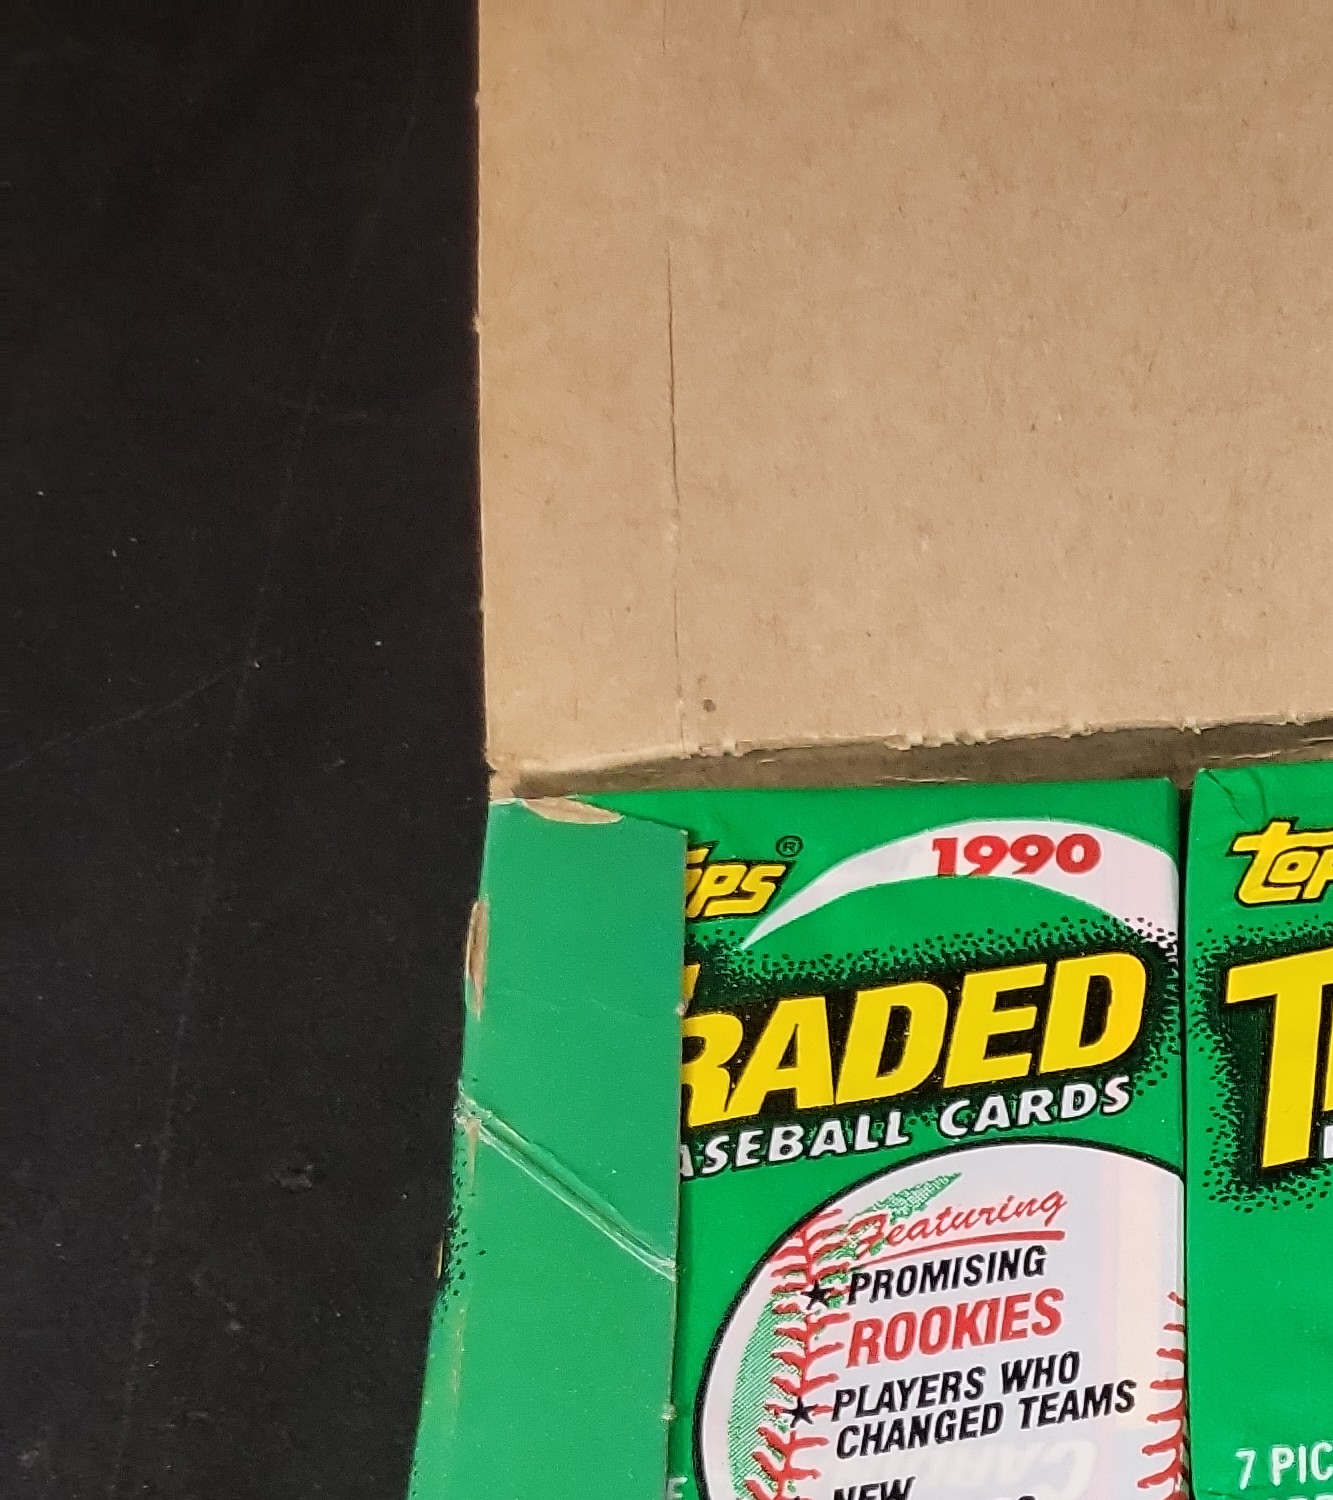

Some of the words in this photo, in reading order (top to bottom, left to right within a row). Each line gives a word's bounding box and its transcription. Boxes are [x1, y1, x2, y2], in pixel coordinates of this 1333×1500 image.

[932, 833, 1102, 877] 1990
[682, 952, 1146, 1127] RADED
[940, 1076, 1130, 1137] CARDS
[846, 1190, 1067, 1255] Featuring
[848, 1246, 1045, 1305] PROMISING
[846, 1289, 1064, 1368] ROOKIES
[832, 1366, 983, 1421] PLAYERS
[1002, 1351, 1080, 1394] WHO
[837, 1402, 1011, 1459] CHANGED
[1021, 1379, 1138, 1429] TEAMS
[1235, 1449, 1258, 1490] 7
